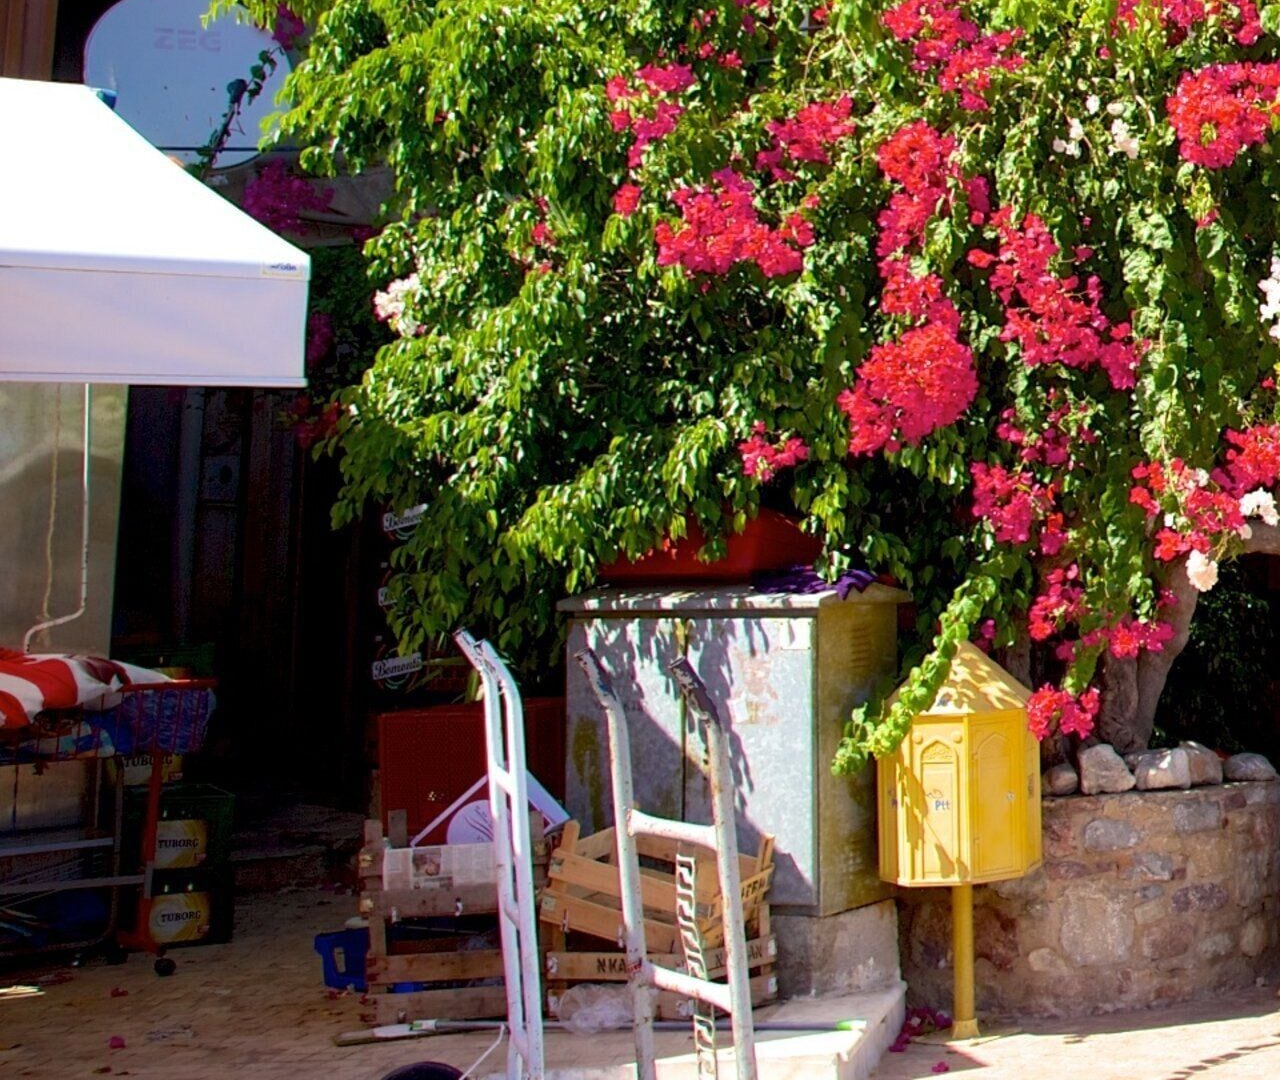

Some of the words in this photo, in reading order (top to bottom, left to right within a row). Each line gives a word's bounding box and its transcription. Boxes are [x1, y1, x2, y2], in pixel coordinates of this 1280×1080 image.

[125, 754, 173, 767] TUBG
[935, 799, 951, 811] Ptt
[158, 838, 199, 849] TUBORG
[161, 910, 201, 923] TUBORG
